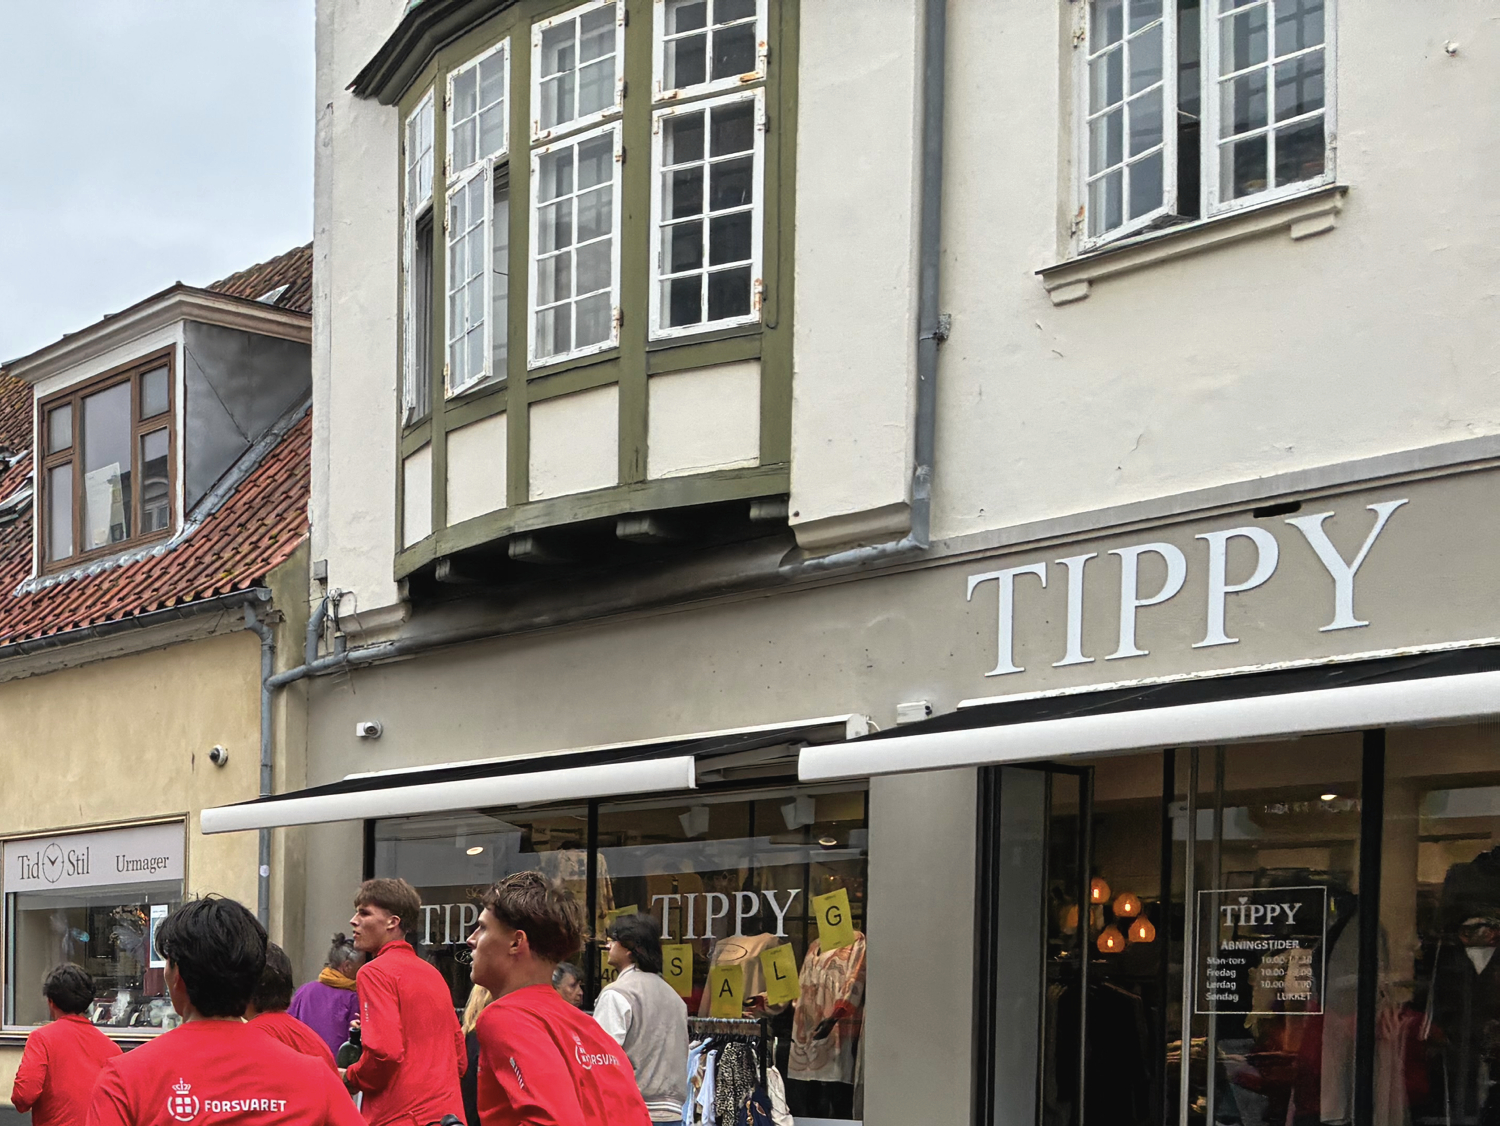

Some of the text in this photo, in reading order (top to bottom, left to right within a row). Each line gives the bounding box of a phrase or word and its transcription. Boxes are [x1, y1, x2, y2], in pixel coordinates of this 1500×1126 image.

[966, 498, 1410, 677] TIPPY
[17, 846, 170, 880] Tid Stil Urmager
[420, 902, 481, 946] TIP
[651, 888, 802, 940] TIPPY
[1220, 897, 1302, 926] TIPPY
[670, 905, 842, 998] S A L G
[1220, 939, 1300, 951] ÅBNINGSTIDER
[1206, 968, 1237, 979] Fredag
[1206, 980, 1237, 991] Lørdag
[1205, 992, 1239, 1003] Søndag
[204, 1099, 287, 1113] FORSVARET
